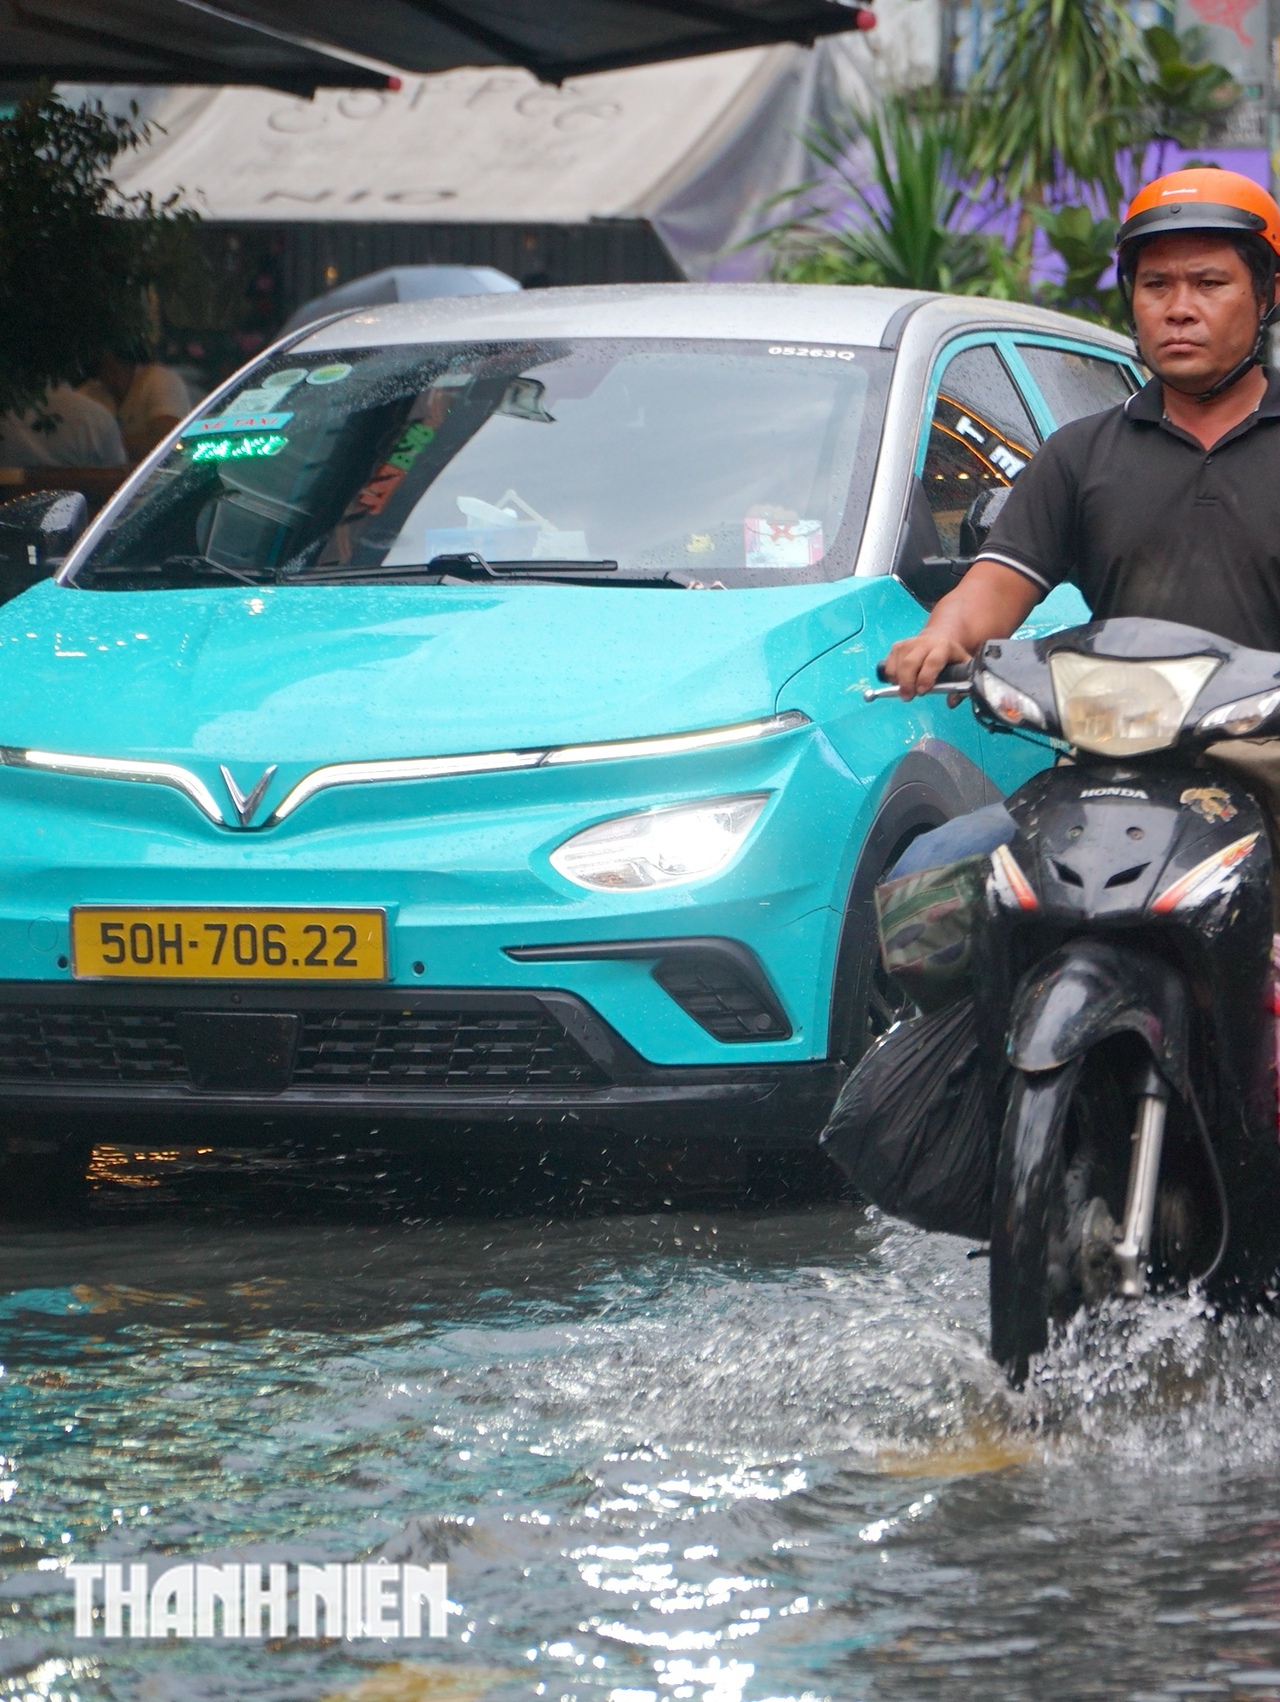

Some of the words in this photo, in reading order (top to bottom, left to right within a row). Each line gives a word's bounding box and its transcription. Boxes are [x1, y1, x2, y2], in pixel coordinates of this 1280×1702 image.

[233, 416, 279, 429] TAXI
[1079, 787, 1149, 800] HONDA
[100, 921, 358, 968] 50H-706.22
